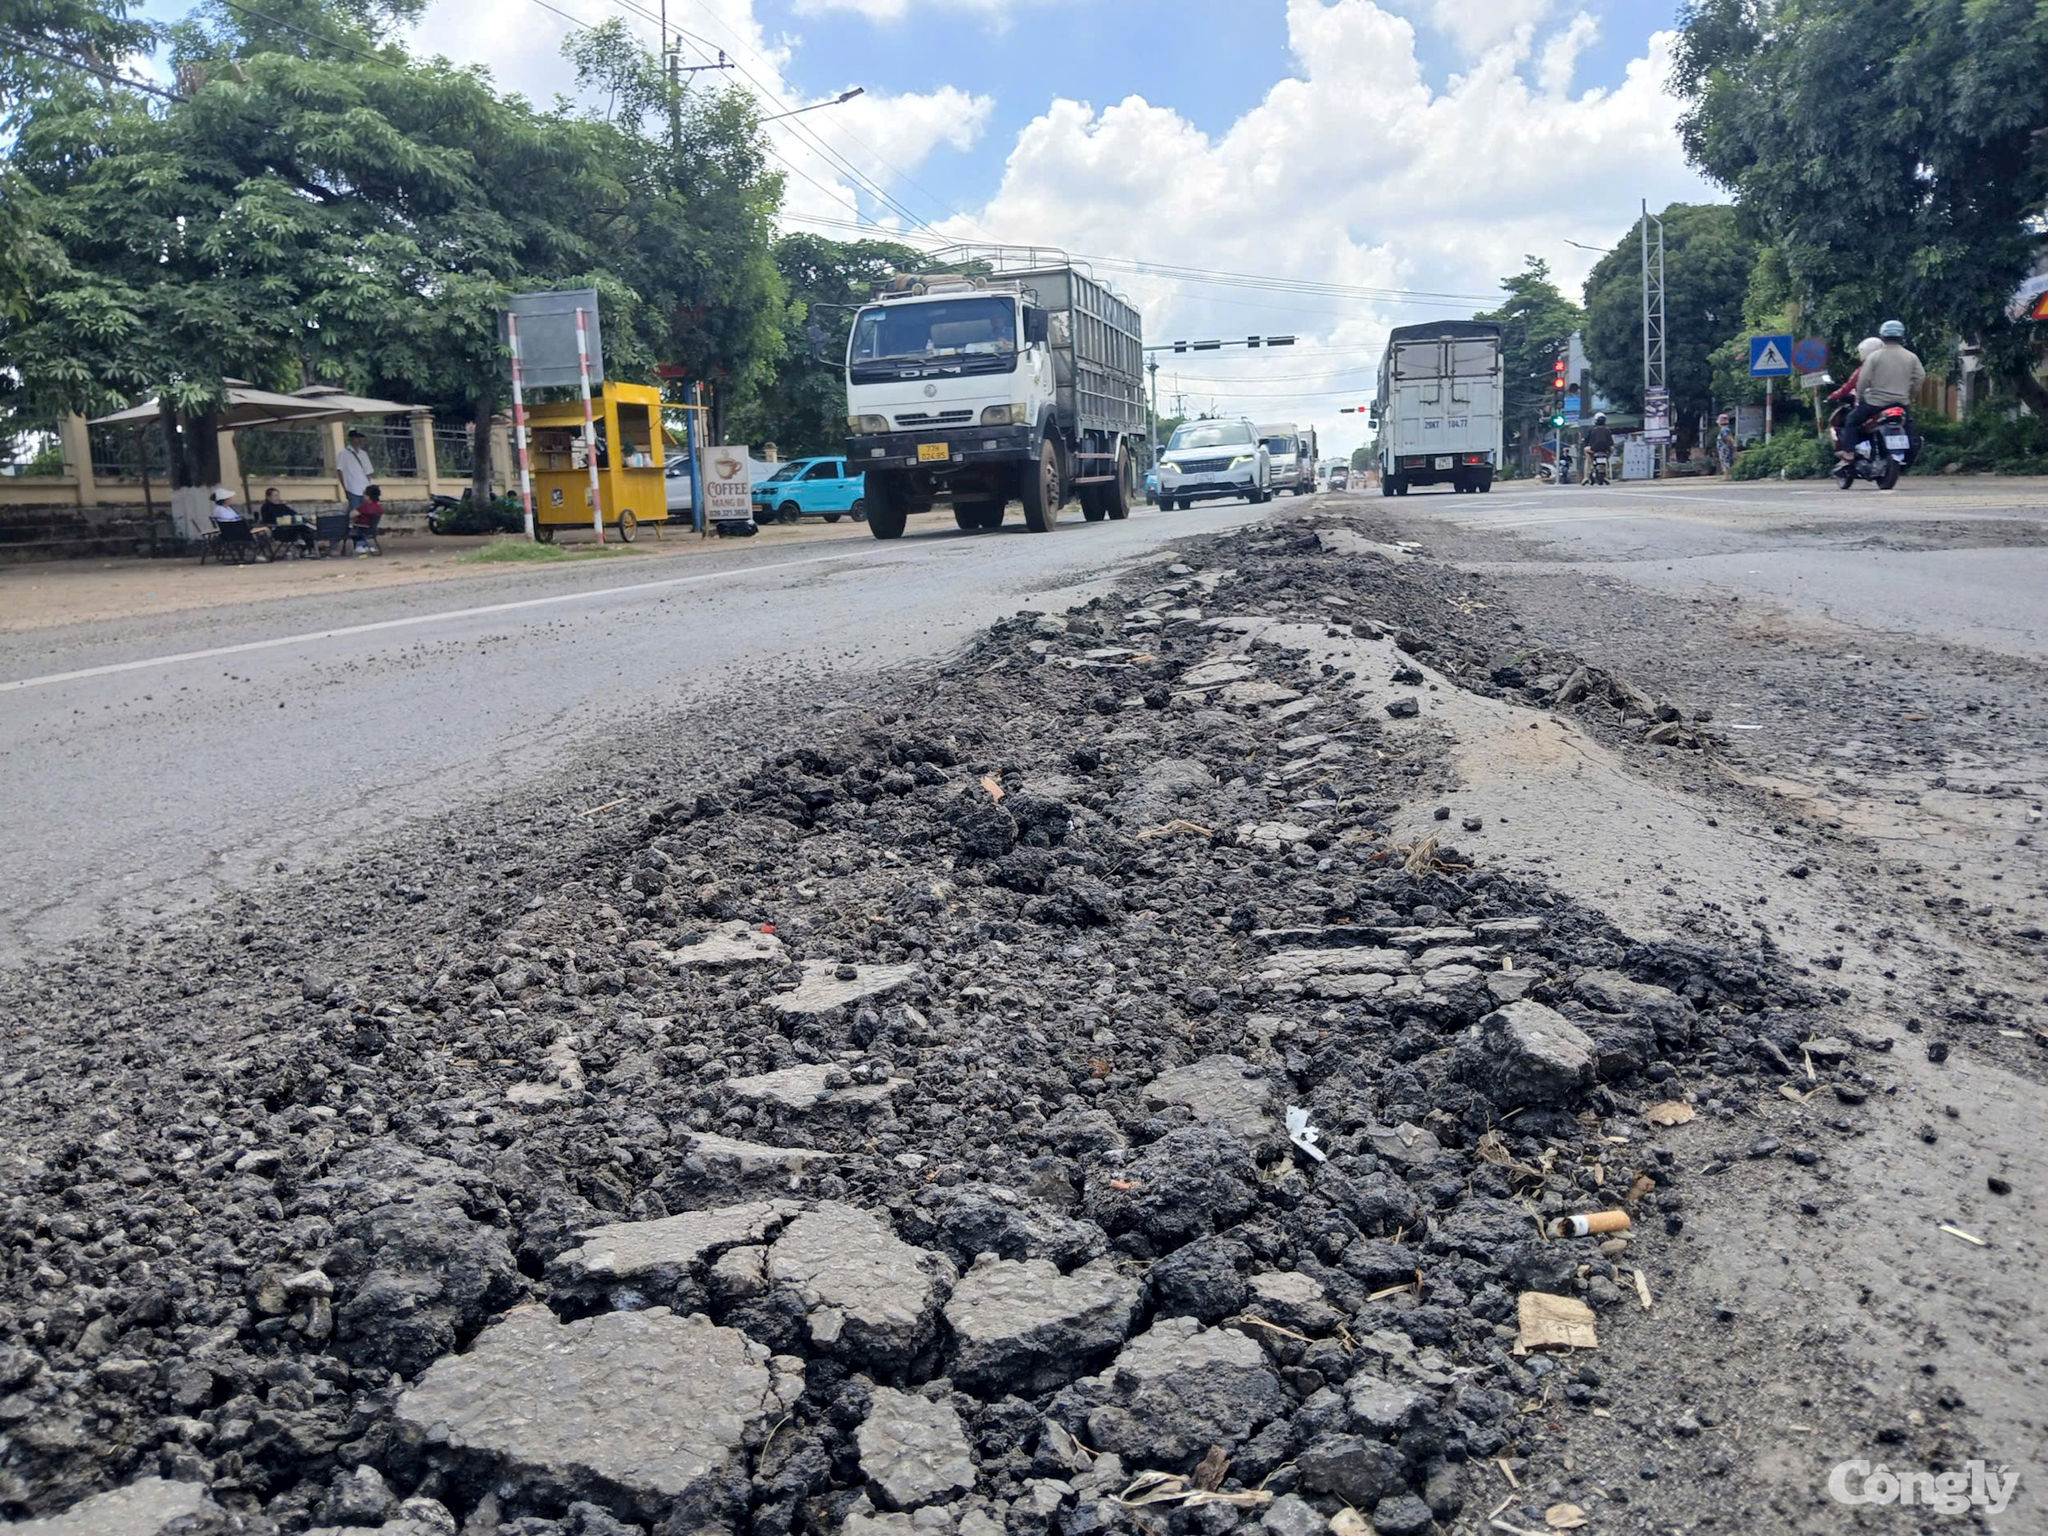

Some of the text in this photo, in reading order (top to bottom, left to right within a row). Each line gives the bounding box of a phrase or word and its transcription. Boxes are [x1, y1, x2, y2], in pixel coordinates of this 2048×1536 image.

[900, 366, 961, 378] DFM
[707, 481, 748, 498] COFFEE
[712, 498, 736, 507] MANG
